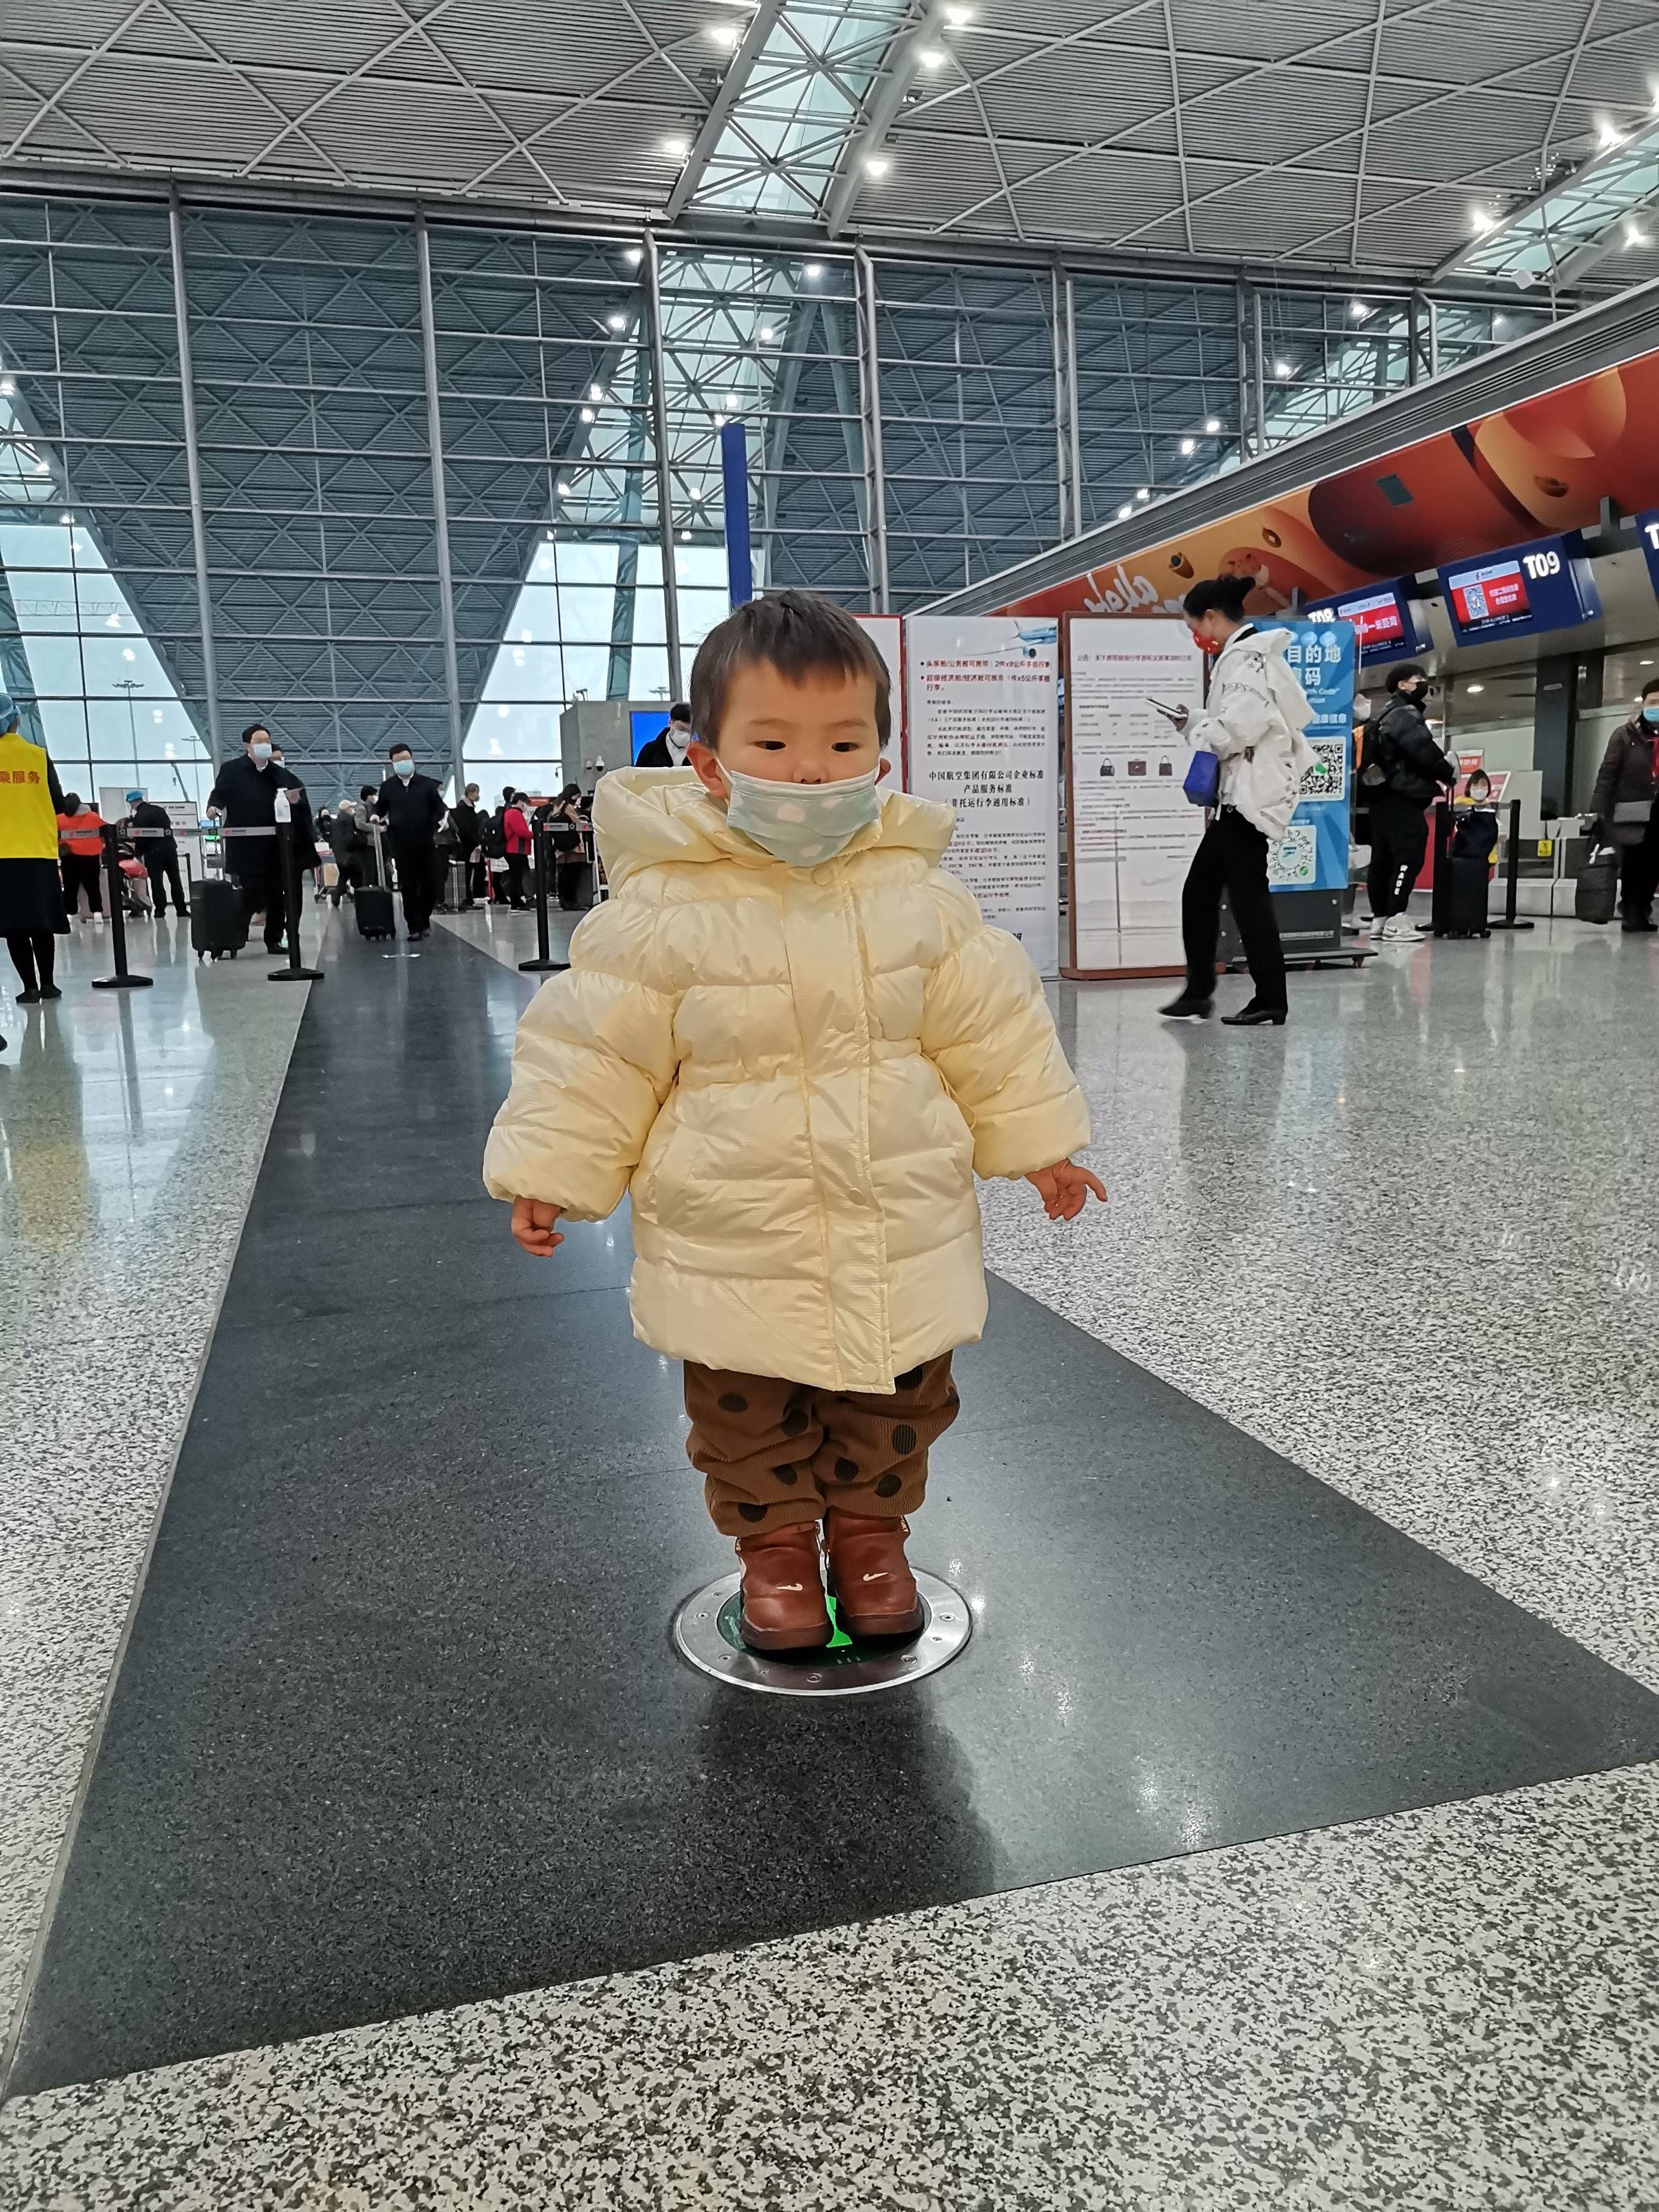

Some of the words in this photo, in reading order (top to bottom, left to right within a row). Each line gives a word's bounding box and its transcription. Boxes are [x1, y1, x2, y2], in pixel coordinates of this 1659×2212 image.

[1523, 551, 1560, 579] T09
[1287, 644, 1341, 663] 目的地
[929, 770, 1044, 781] 中国航空集团有限公司企业标准
[964, 784, 1012, 794] 产品服务标准
